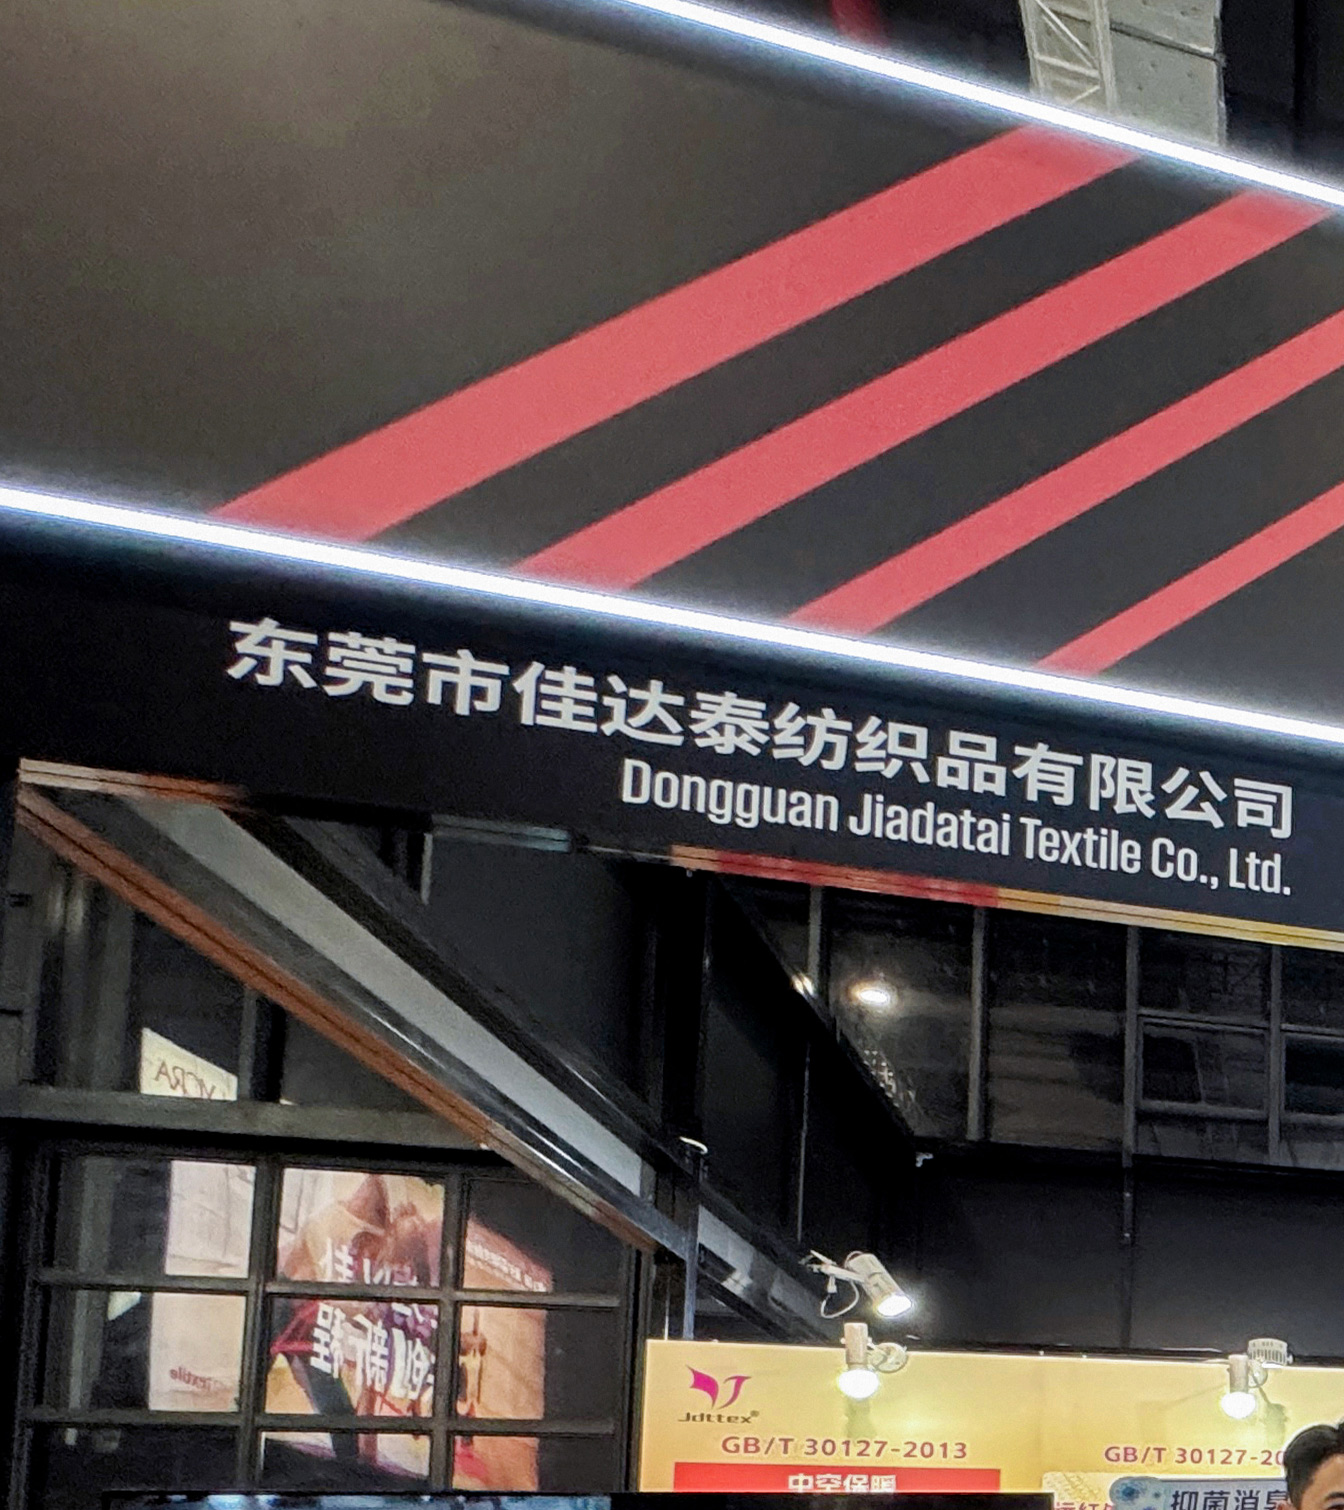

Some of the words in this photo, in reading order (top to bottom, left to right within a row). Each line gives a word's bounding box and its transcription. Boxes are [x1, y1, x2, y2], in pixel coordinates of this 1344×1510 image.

[226, 617, 1294, 839] 东莞市佳达泰纺织品有限公司
[622, 757, 838, 830] Dongguan
[850, 796, 1010, 856] Jiadatai
[1020, 817, 1141, 873] Textile
[1151, 837, 1218, 889] Co.,
[1229, 853, 1291, 895] Ltd.
[722, 1436, 794, 1457] GB/T
[804, 1438, 968, 1459] 30127-2013
[1104, 1445, 1166, 1465] GB/T
[1175, 1446, 1285, 1466] 30127-20
